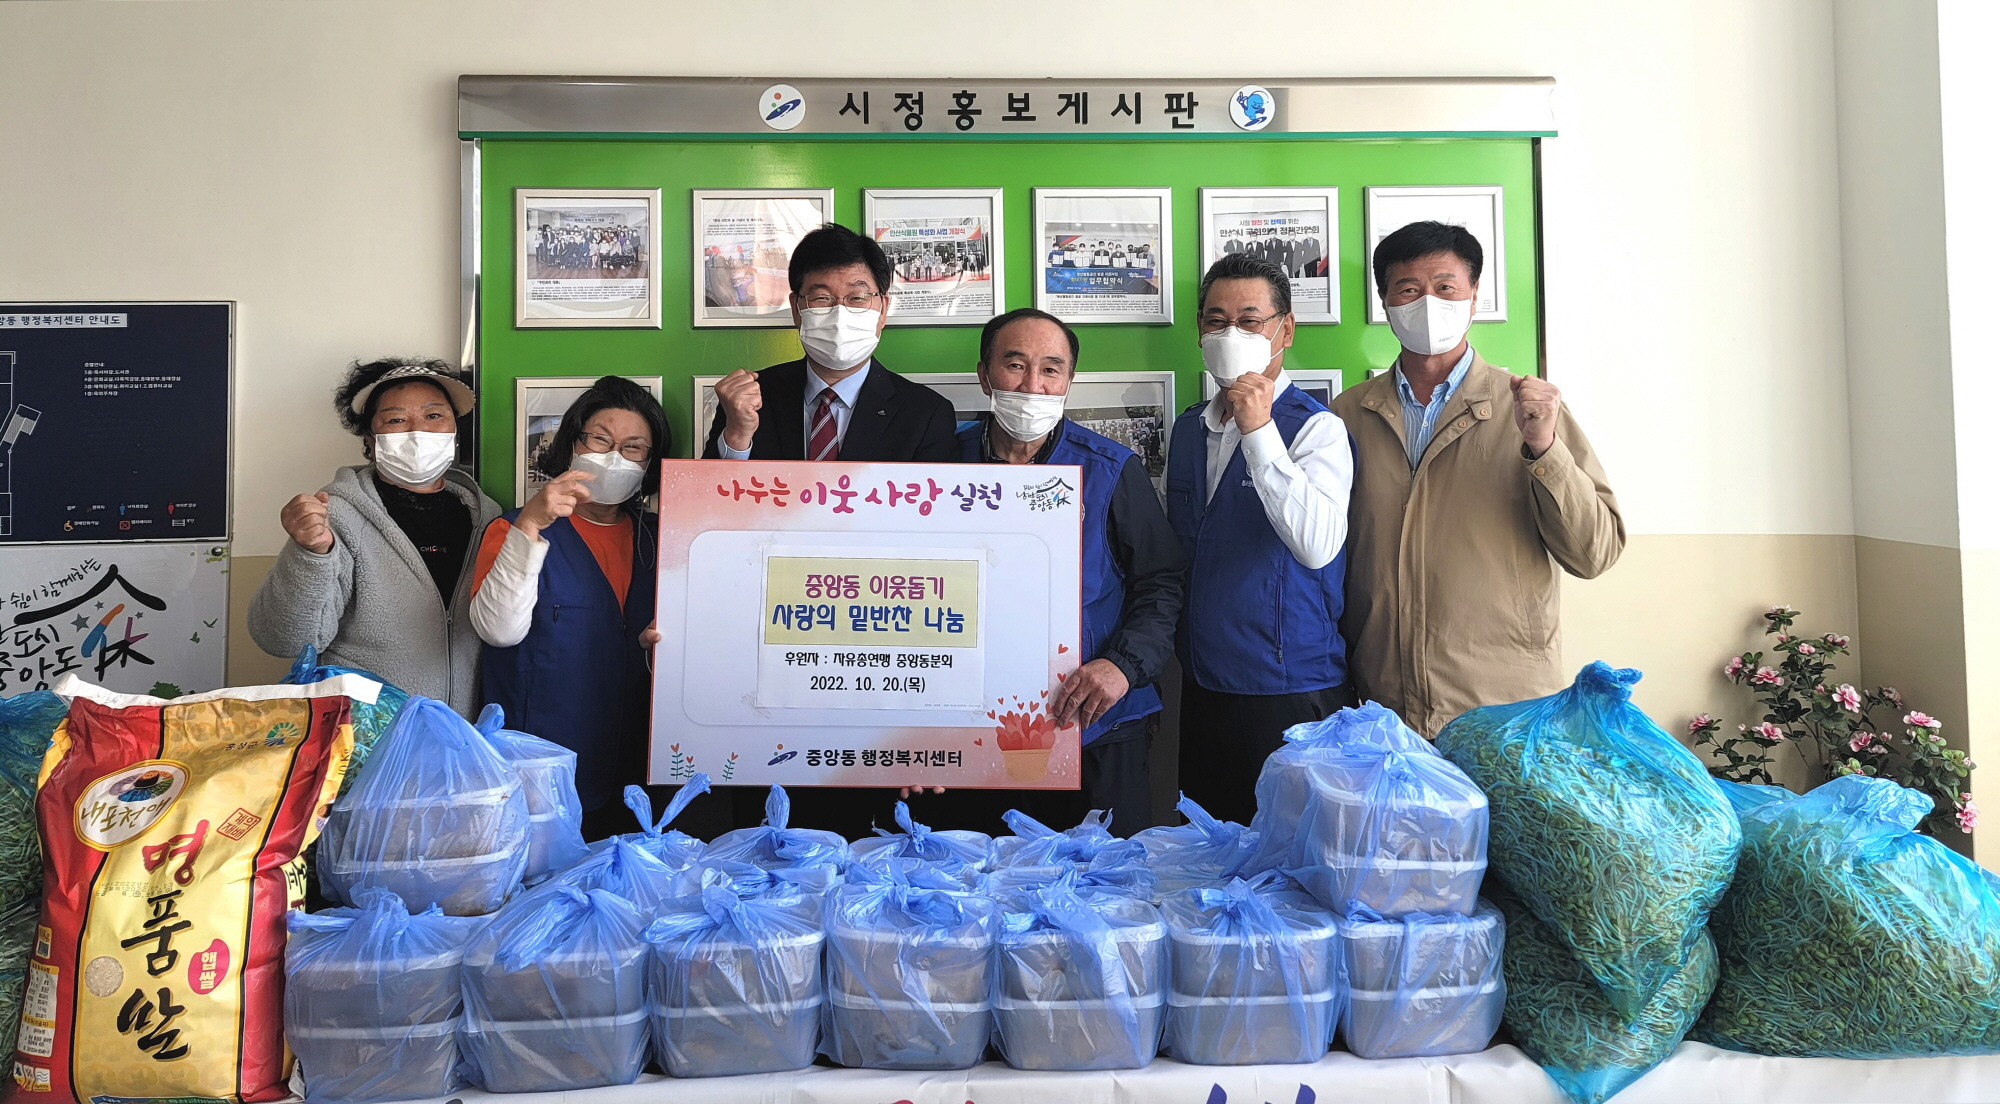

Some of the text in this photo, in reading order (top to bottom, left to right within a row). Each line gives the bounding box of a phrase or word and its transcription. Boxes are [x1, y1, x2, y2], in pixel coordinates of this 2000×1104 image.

[839, 90, 1199, 130] 시정홍보게시판
[1089, 277, 1123, 285] 업무협약식
[20, 315, 84, 326] 행정복지센터
[88, 315, 121, 325] 안내도
[717, 474, 1002, 516] 나누는 이웃 사랑 실천
[1029, 499, 1053, 512] 중앙동
[41, 558, 102, 597] 함께하는
[805, 574, 944, 600] 중앙동 이웃돕기
[772, 604, 965, 633] 사랑의 밑반찬 나눔
[784, 651, 819, 666] 후원자
[833, 653, 890, 667] 자유총연맹
[896, 654, 952, 669] 중앙동분회
[810, 676, 926, 693] 2022. 10. 20.(목)
[806, 749, 962, 767] 중앙동 행정복지센터
[116, 819, 209, 1061] 명품쌀
[198, 951, 218, 990] 햅쌀
